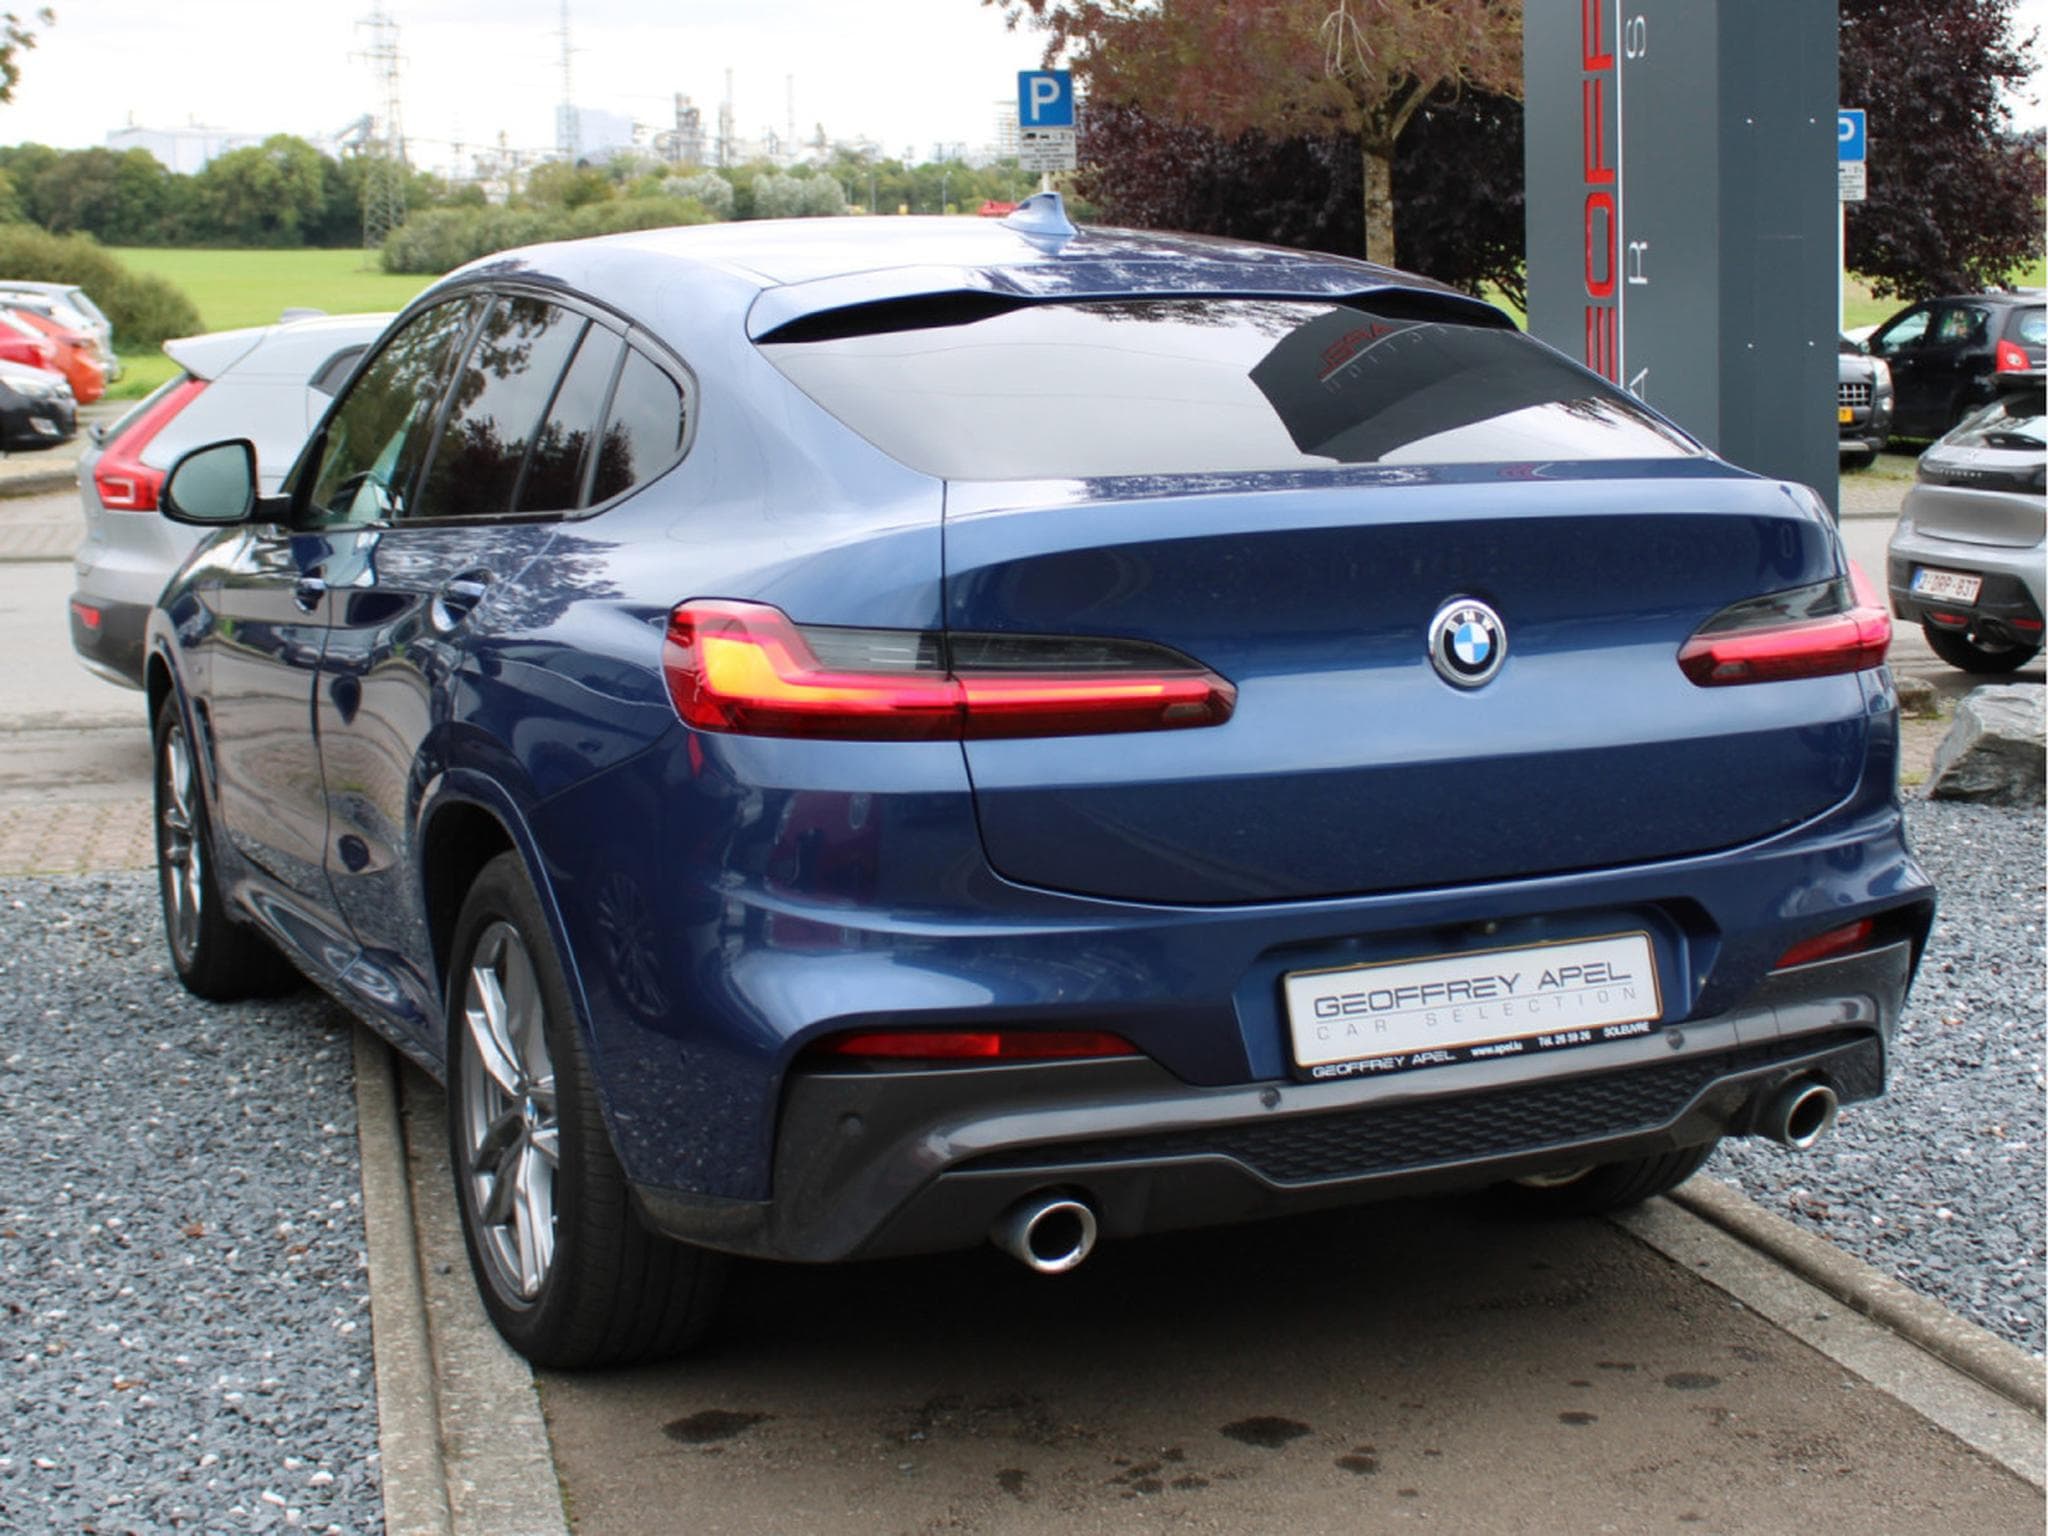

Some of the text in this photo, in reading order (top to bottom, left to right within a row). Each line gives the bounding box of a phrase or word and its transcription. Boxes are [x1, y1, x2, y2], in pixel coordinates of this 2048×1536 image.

[1030, 77, 1060, 121] P
[1313, 961, 1631, 1018] GEOFFREY APEL
[1316, 986, 1636, 1041] CAR SELECTION
[1312, 1056, 1406, 1078] GEOFFREY
[1411, 1050, 1456, 1066] APEL
